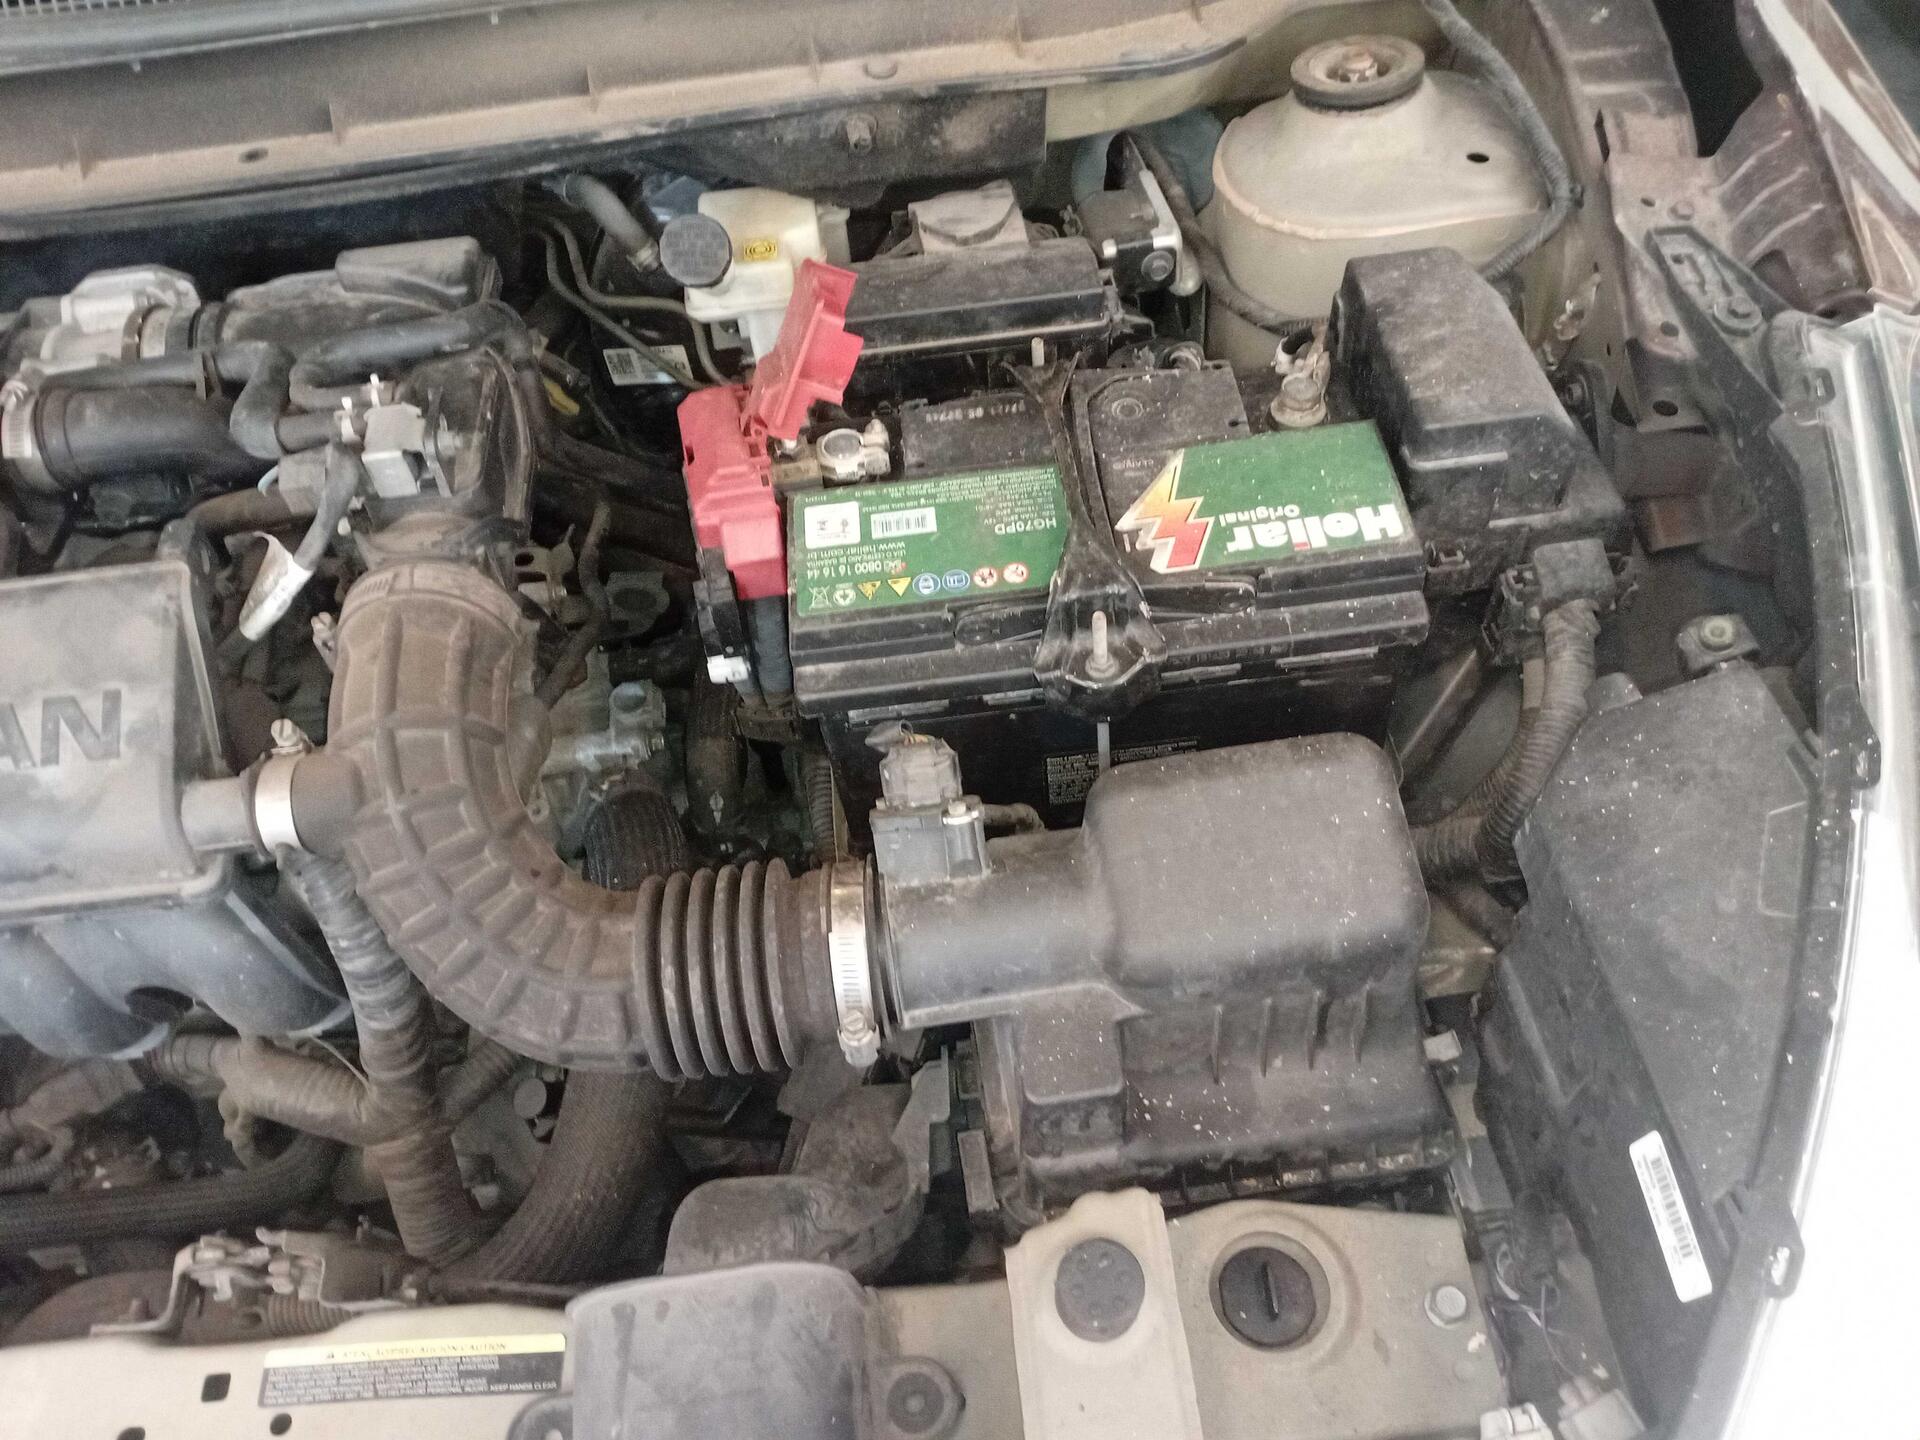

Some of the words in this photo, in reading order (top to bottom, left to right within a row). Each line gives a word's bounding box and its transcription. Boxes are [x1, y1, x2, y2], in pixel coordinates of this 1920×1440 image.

[1219, 504, 1300, 527] Original
[994, 517, 1057, 535] HG70PD
[1226, 504, 1404, 553] Heliar
[807, 568, 820, 580] 44
[822, 566, 836, 578] 16
[839, 564, 851, 577] 16
[854, 560, 881, 575] 0800
